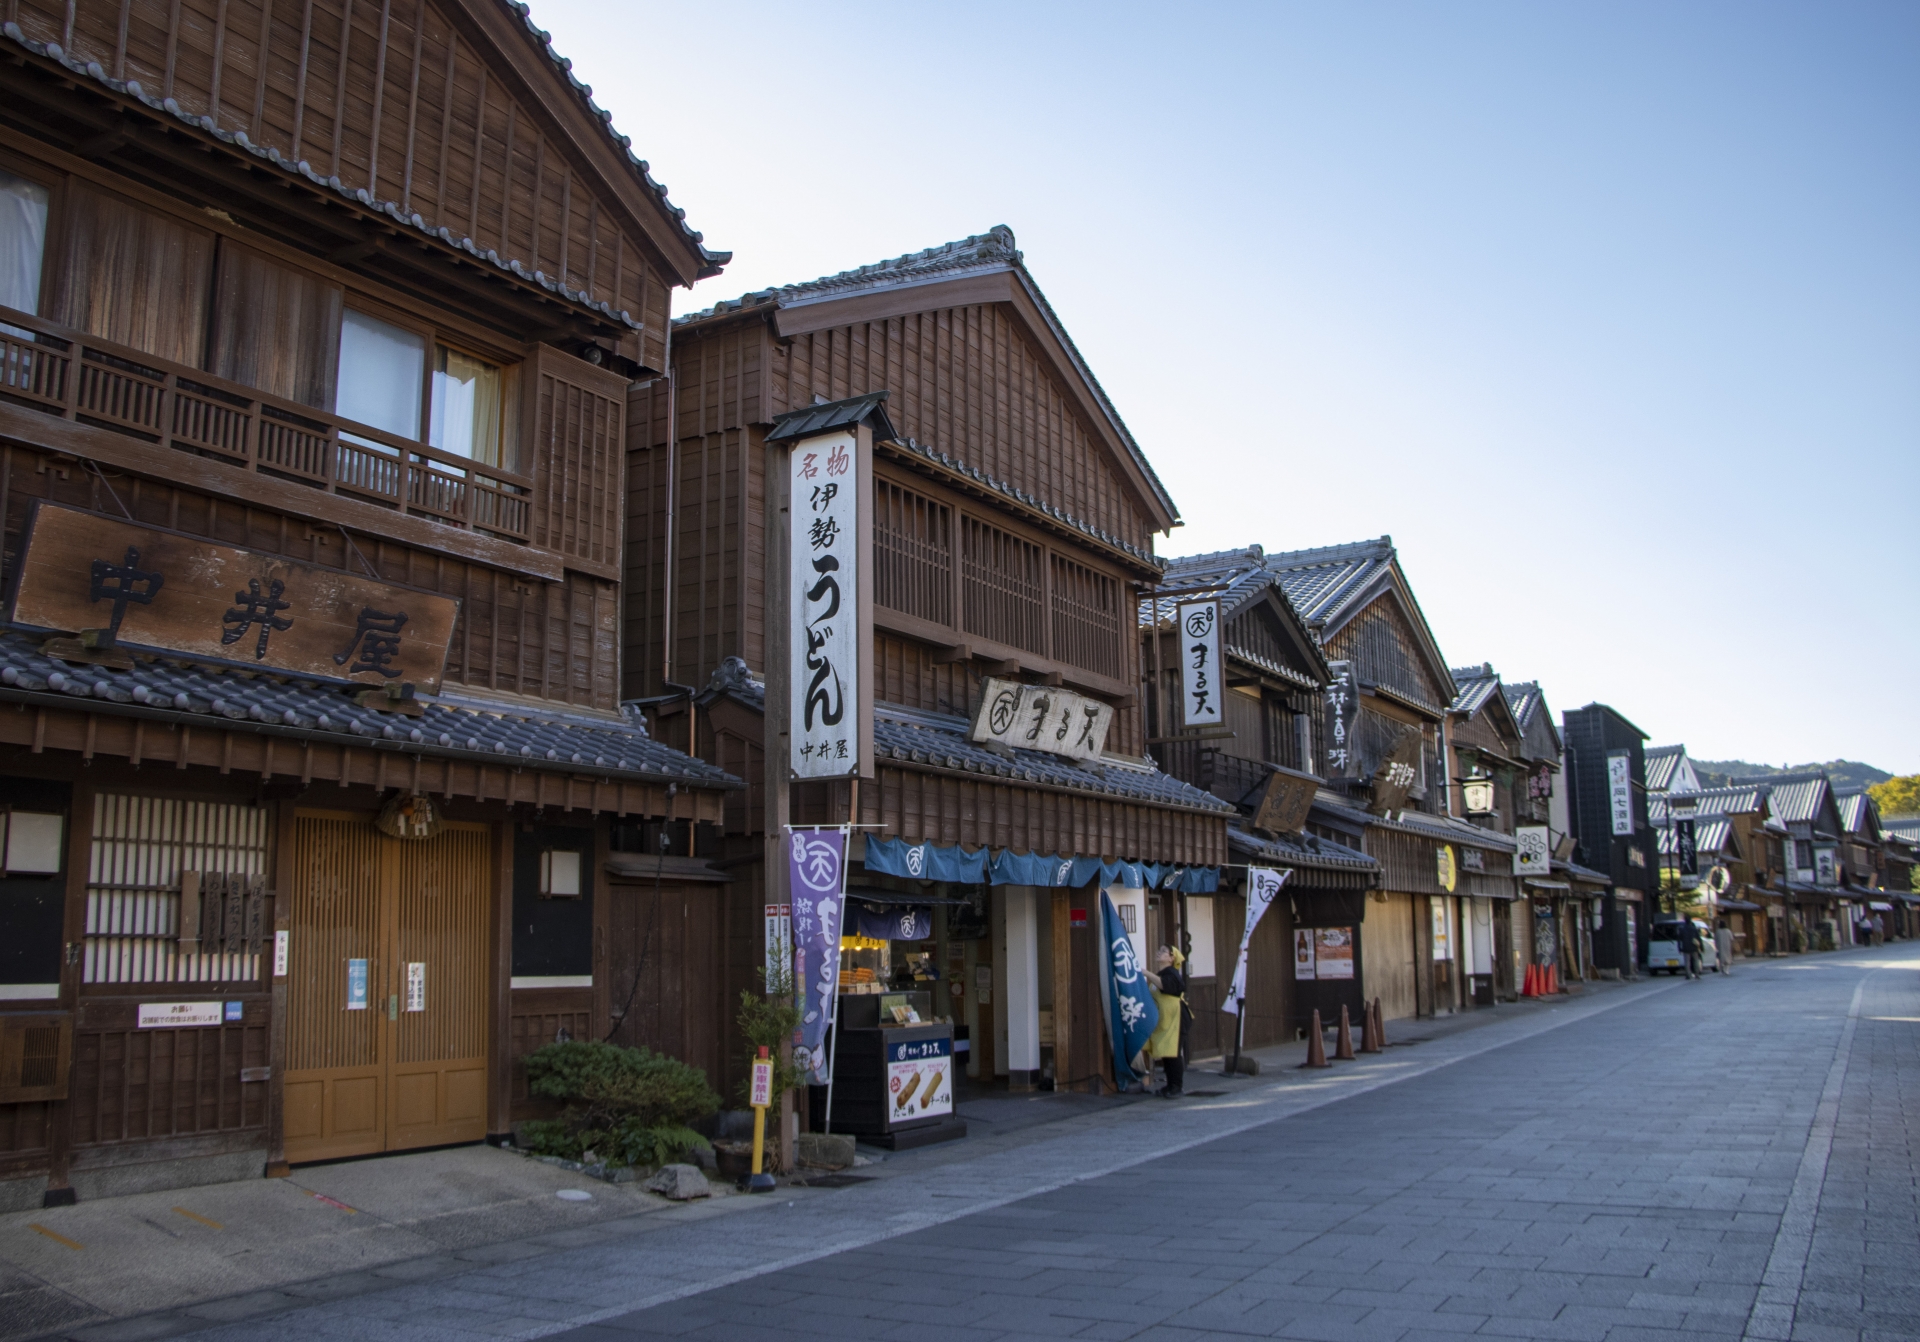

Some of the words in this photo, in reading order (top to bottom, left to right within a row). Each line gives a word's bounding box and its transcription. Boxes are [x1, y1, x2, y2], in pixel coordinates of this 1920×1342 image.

[797, 446, 849, 479] 名物
[90, 545, 409, 678] 中井屋
[804, 482, 843, 732] 伊勢うどん
[1190, 643, 1215, 715] まる天
[1026, 693, 1099, 752] まる天
[800, 739, 849, 762] 中井屋
[171, 1005, 193, 1013] お願い
[756, 1065, 767, 1102] 駐車禁止
